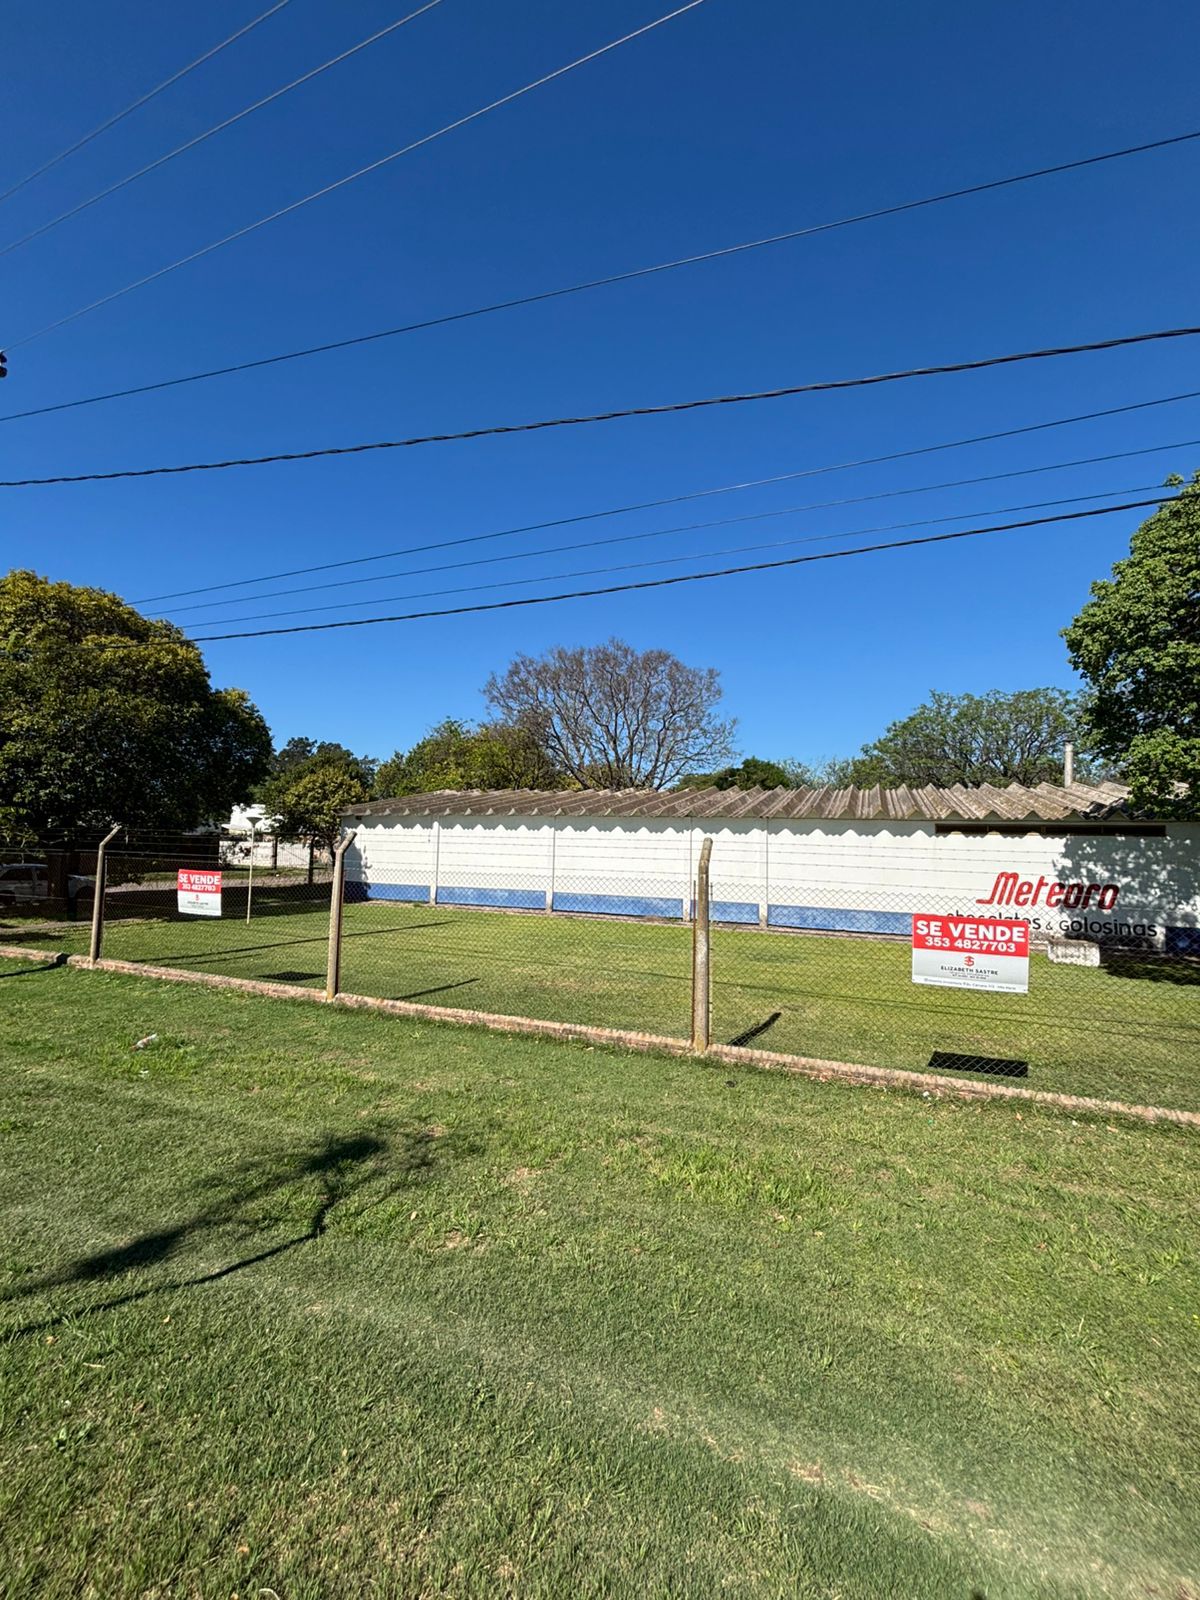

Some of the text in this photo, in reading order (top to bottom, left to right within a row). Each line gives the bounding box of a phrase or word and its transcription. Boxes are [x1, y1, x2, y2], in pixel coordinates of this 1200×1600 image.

[179, 873, 221, 885] SE VENDE
[975, 872, 1120, 909] Meteoro
[916, 920, 1026, 942] SE VENDE
[1045, 922, 1053, 930] &
[925, 936, 1016, 952] 353 4827703
[940, 965, 974, 973] ELIZABETH
[975, 968, 999, 976] SASTRE
